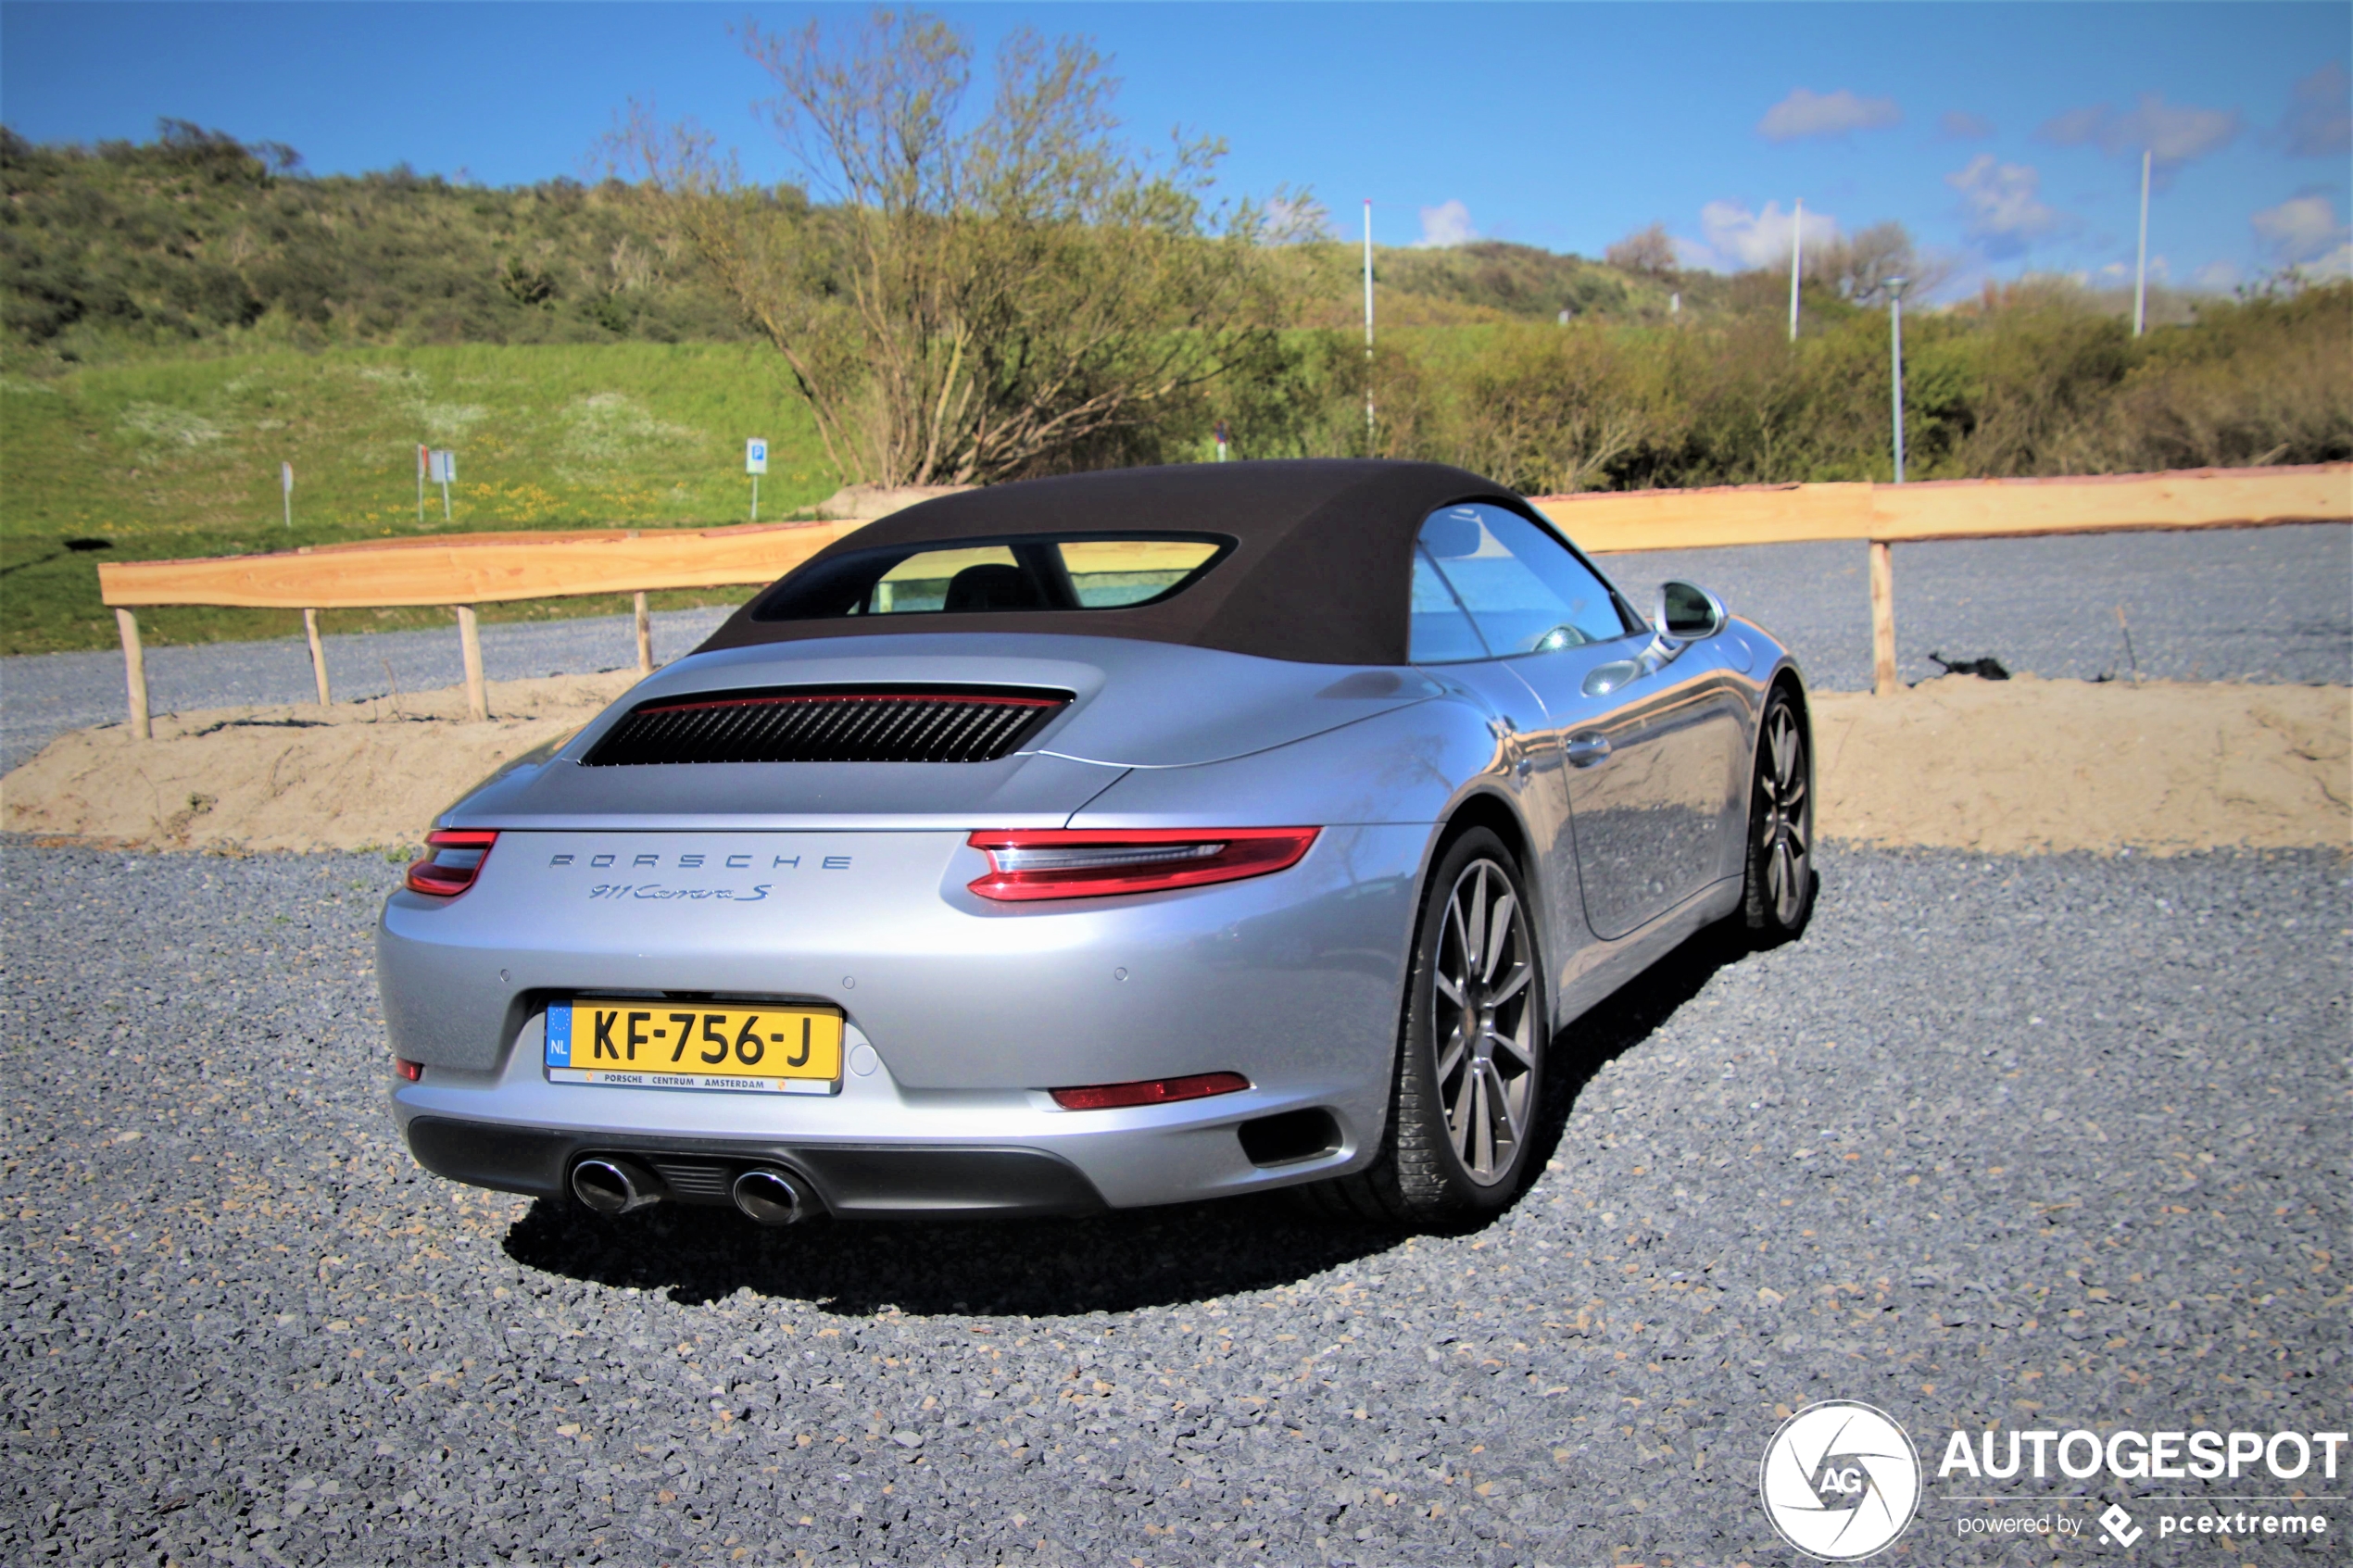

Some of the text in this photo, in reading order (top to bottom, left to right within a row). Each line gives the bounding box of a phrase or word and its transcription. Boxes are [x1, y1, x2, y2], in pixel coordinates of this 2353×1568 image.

[549, 854, 852, 870] PORSCHE
[589, 884, 775, 901] 911 Carrera S
[594, 1010, 812, 1067] KF-756-J
[550, 1039, 568, 1055] NL
[604, 1073, 764, 1089] PORSCHE CENTRUM AMSTERDAM
